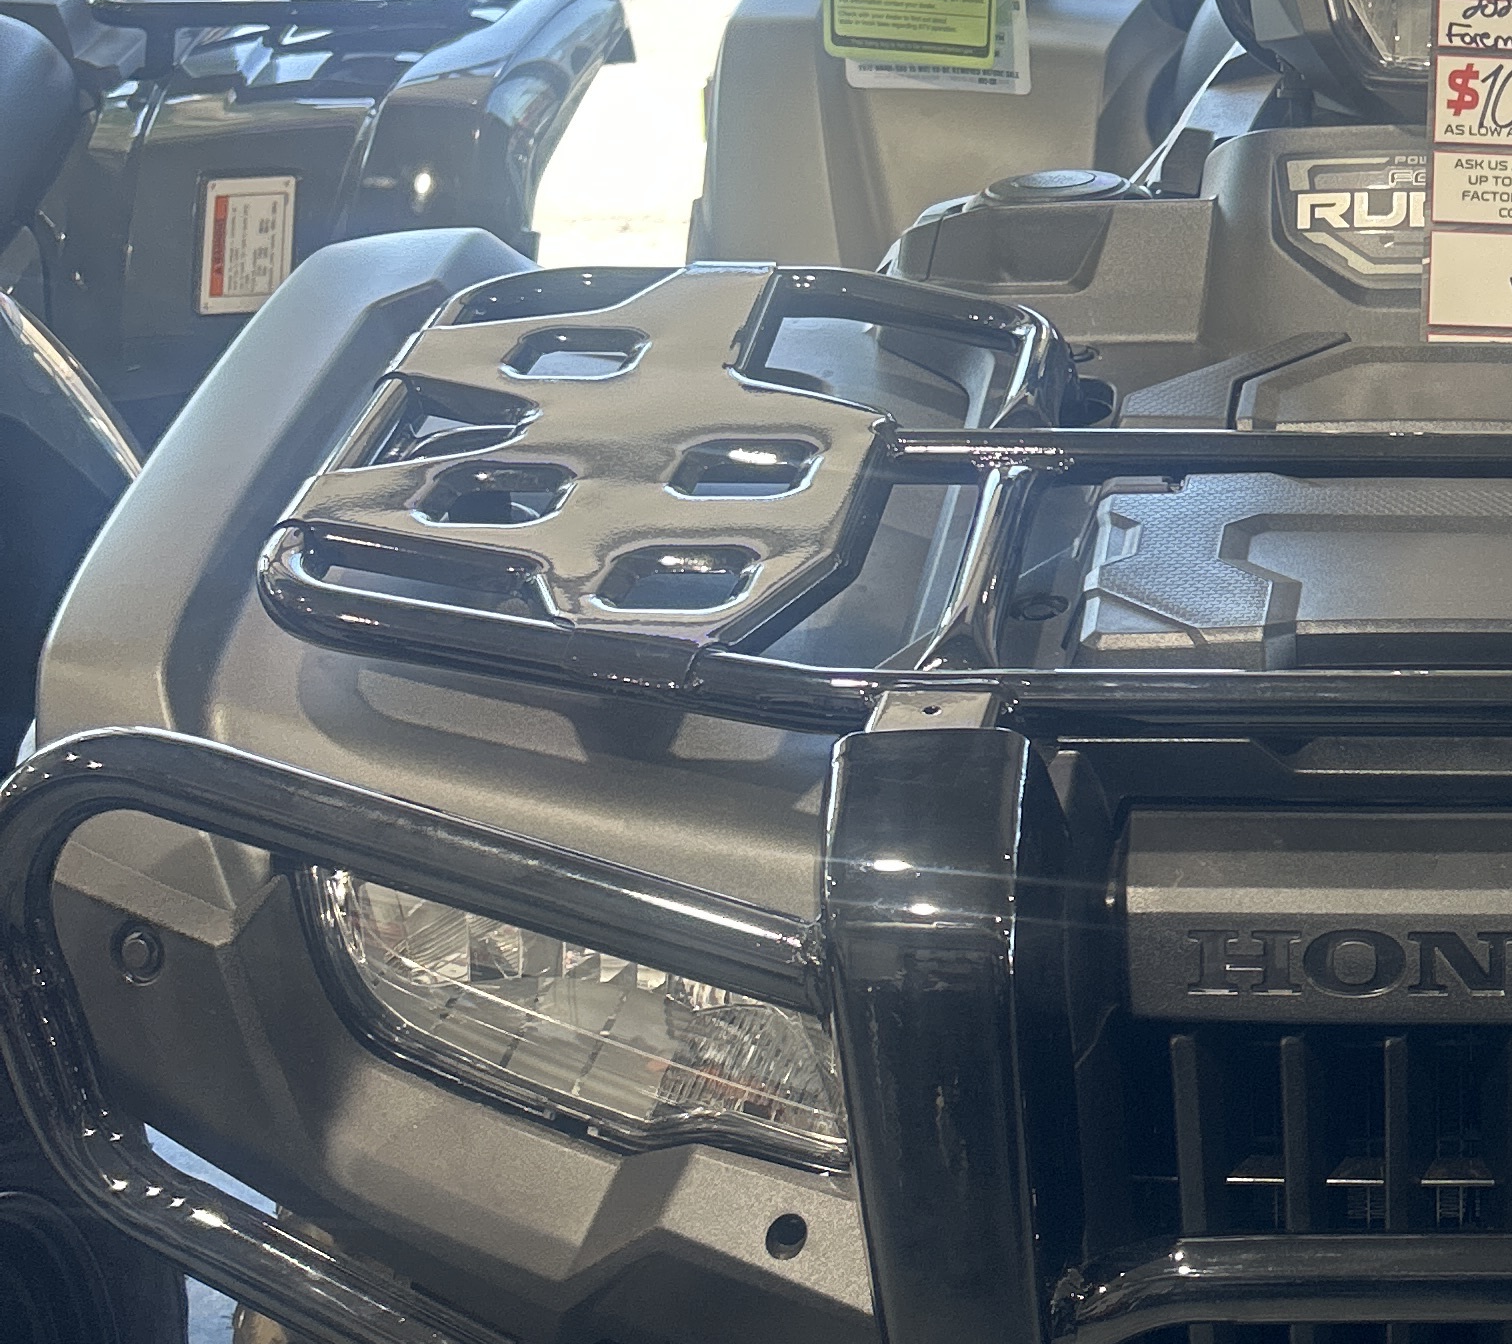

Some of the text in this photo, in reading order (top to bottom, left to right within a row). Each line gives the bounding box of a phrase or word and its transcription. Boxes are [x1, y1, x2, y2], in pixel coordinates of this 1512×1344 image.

[1443, 123, 1466, 136] AS
[1468, 125, 1503, 138] LOW
[1454, 158, 1484, 170] ASK
[1487, 160, 1508, 171] US
[1468, 175, 1488, 186] UP
[1491, 175, 1512, 187] TO
